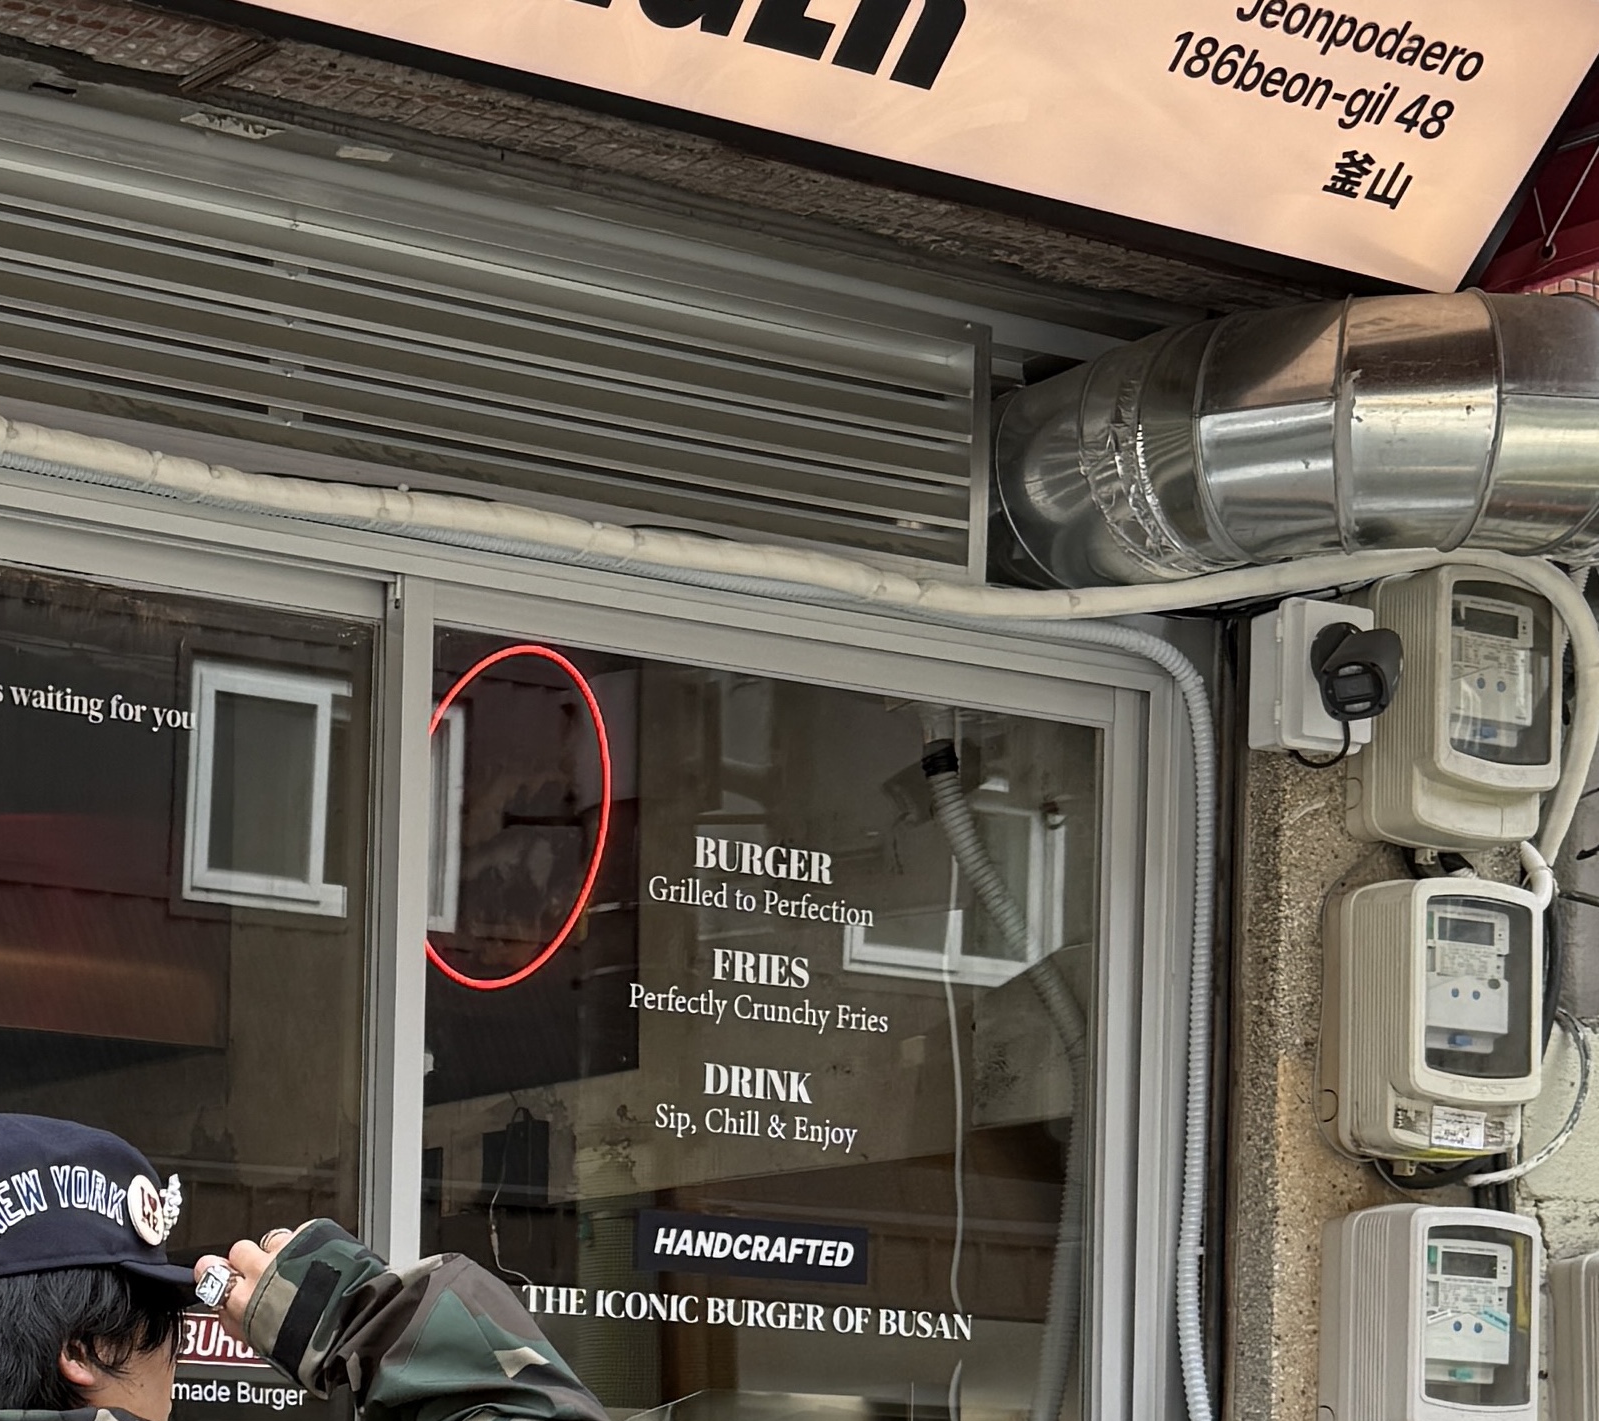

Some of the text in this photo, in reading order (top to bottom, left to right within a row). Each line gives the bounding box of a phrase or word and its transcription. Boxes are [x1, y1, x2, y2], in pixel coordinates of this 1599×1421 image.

[1236, 0, 1485, 82] Jeonpodaero
[1168, 30, 1455, 140] 186beon-gil 48
[1322, 149, 1413, 210] 釜山
[9, 680, 104, 724] waiting
[109, 693, 147, 725] for
[151, 704, 197, 734] you
[694, 836, 833, 885] BURGER
[648, 876, 874, 928] Grilled to Perfection
[712, 948, 810, 990] FRIES
[629, 983, 889, 1035] Perfectly Crunchy Fries
[703, 1062, 812, 1105] DRINK
[654, 1103, 858, 1154] Sip, Chill & Enjoy
[50, 1164, 127, 1227] YORK
[653, 1227, 856, 1270] HANDCRAFTED
[522, 1285, 973, 1343] THE ICONIC BURGER OF BUSAN
[237, 1381, 308, 1410] Burger
